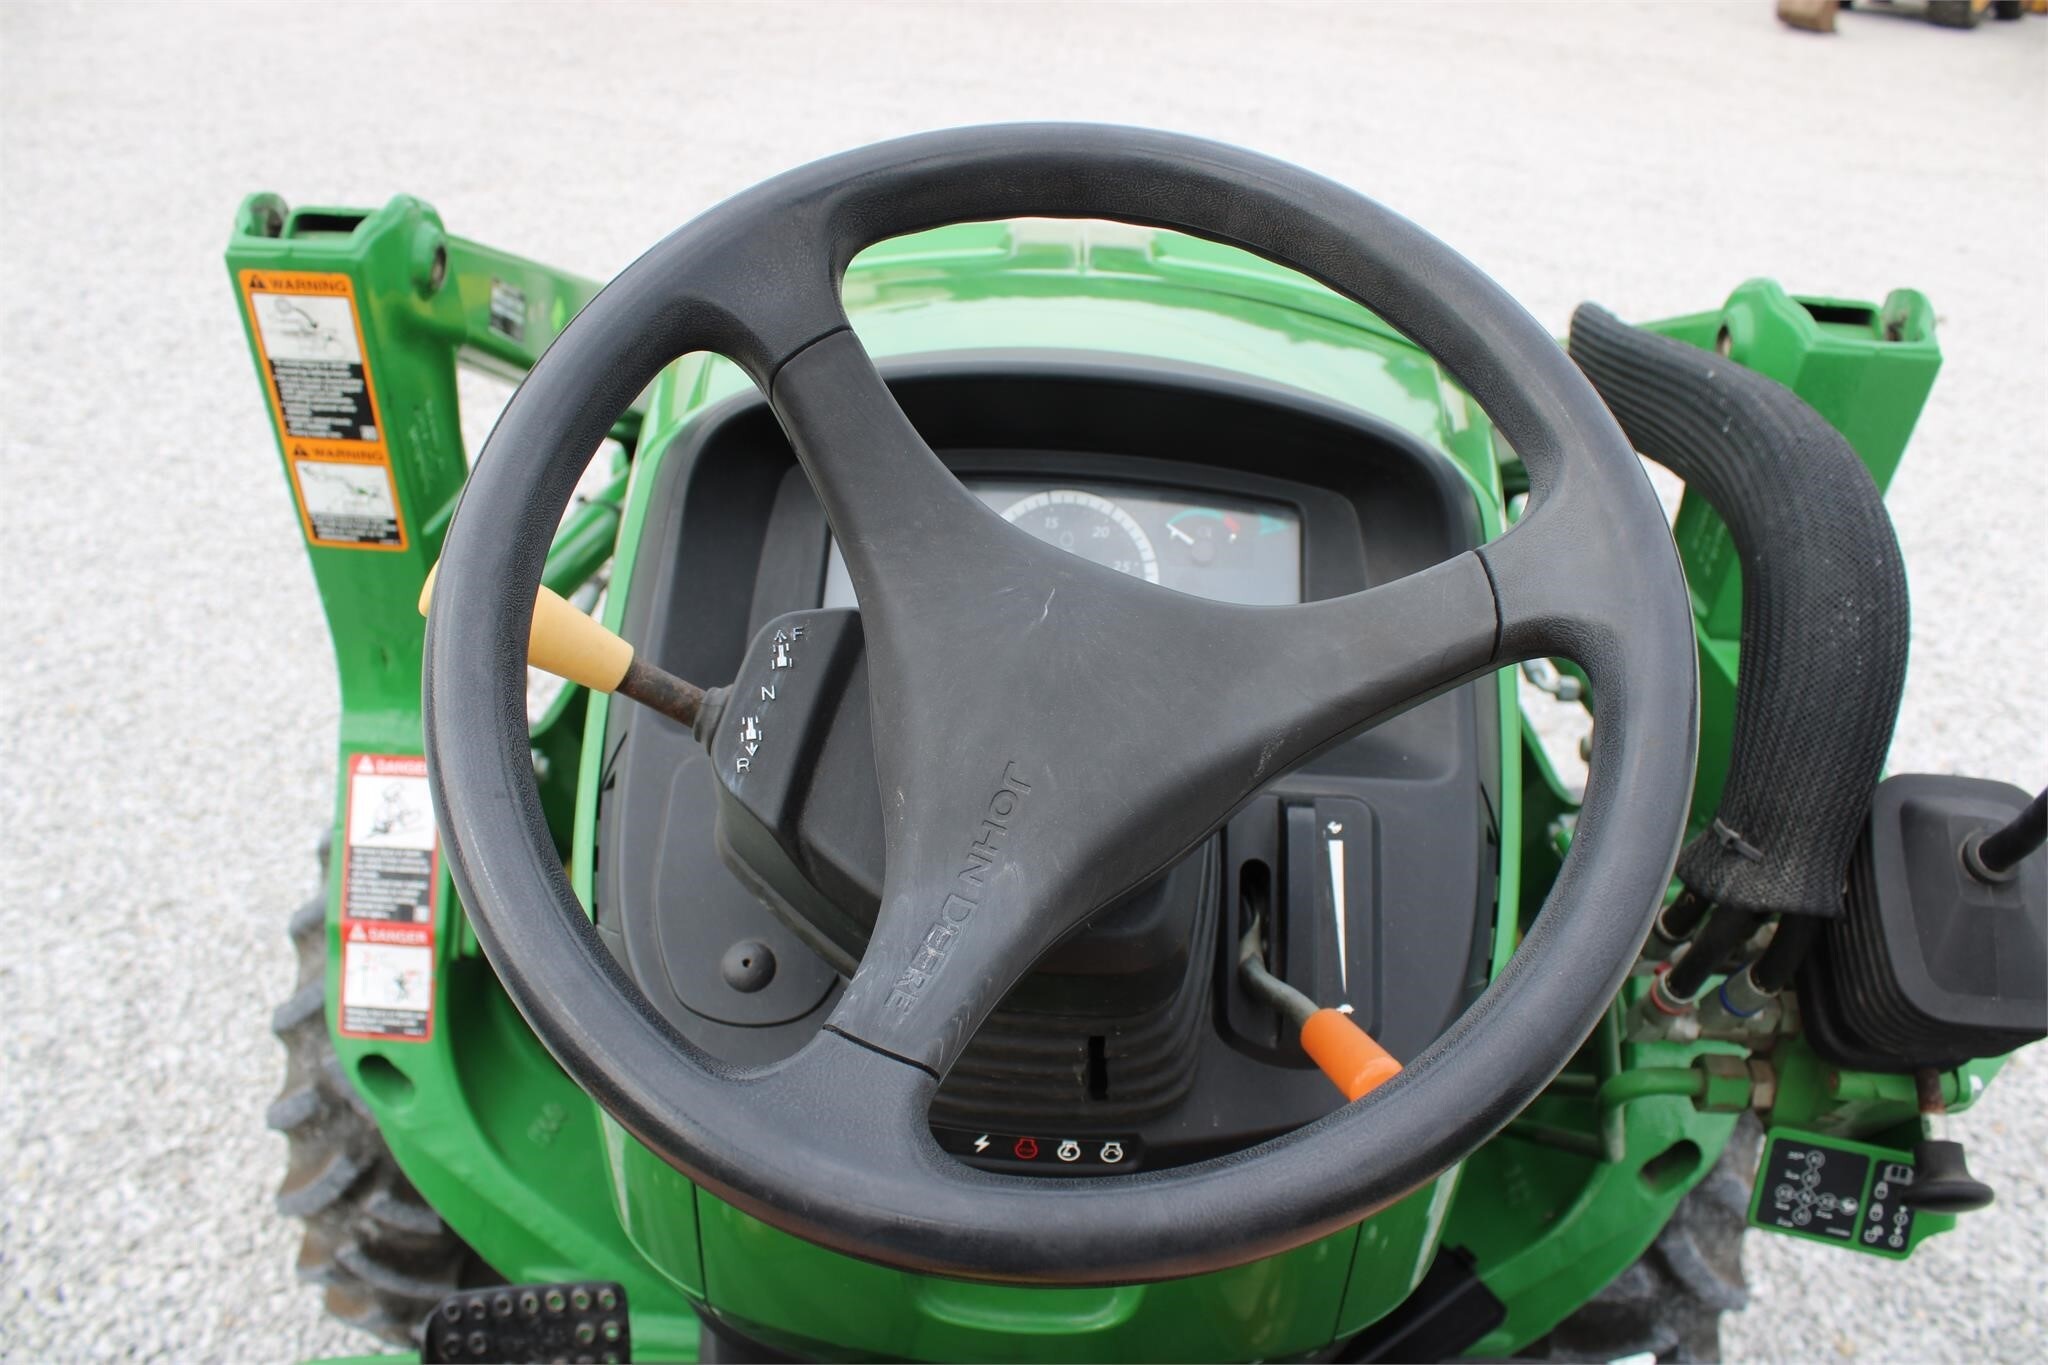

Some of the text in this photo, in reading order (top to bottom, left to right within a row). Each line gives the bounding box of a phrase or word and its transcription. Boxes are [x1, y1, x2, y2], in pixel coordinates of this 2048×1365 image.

[271, 278, 347, 292] WARNING
[312, 448, 384, 461] WARNING
[1045, 516, 1060, 530] 15
[1091, 526, 1111, 539] 20
[792, 627, 804, 641] F
[761, 685, 776, 701] N
[375, 759, 427, 775] DANGE
[736, 757, 751, 773] R
[884, 760, 1032, 1016] JOHN DEERE
[367, 927, 429, 946] DANGER
